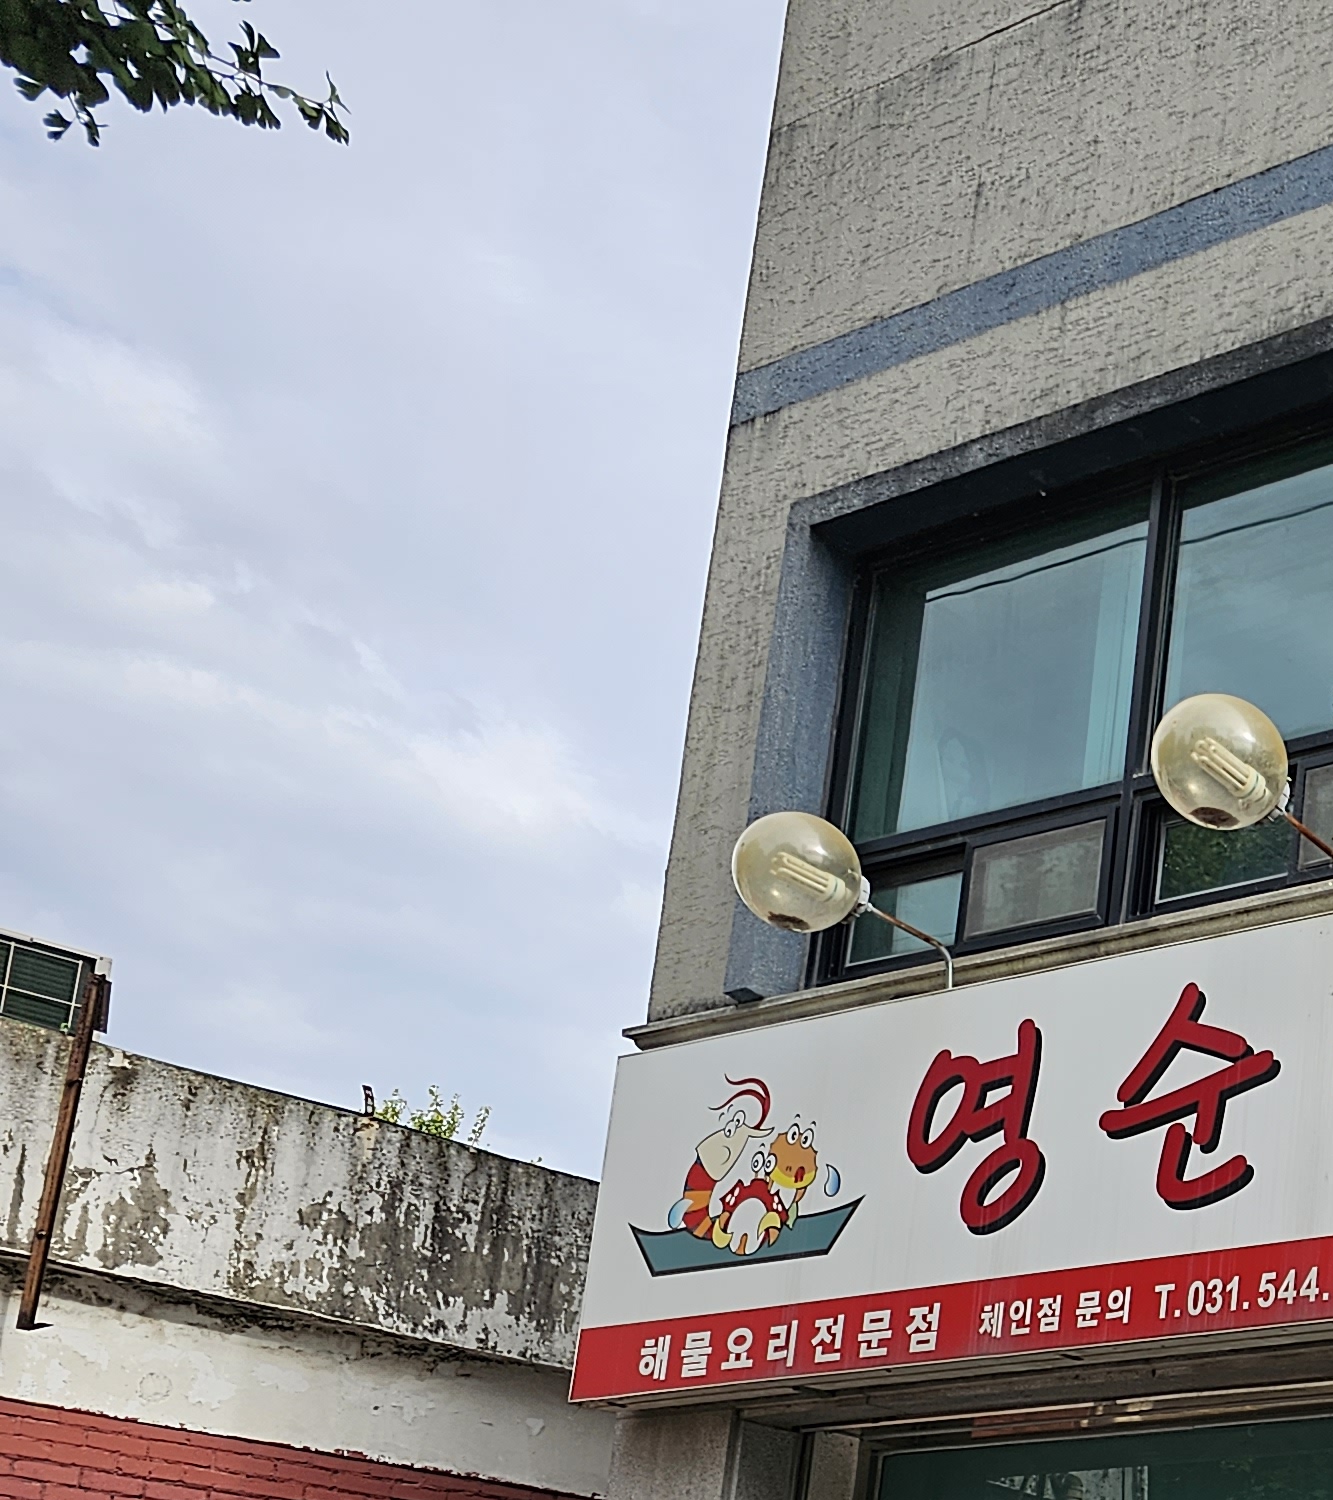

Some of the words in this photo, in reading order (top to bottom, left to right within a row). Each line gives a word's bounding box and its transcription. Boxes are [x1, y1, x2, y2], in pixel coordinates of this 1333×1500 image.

[640, 1302, 942, 1382] 해물요리전문점
[979, 1295, 1061, 1340] 체인점
[1076, 1285, 1132, 1330] 문의
